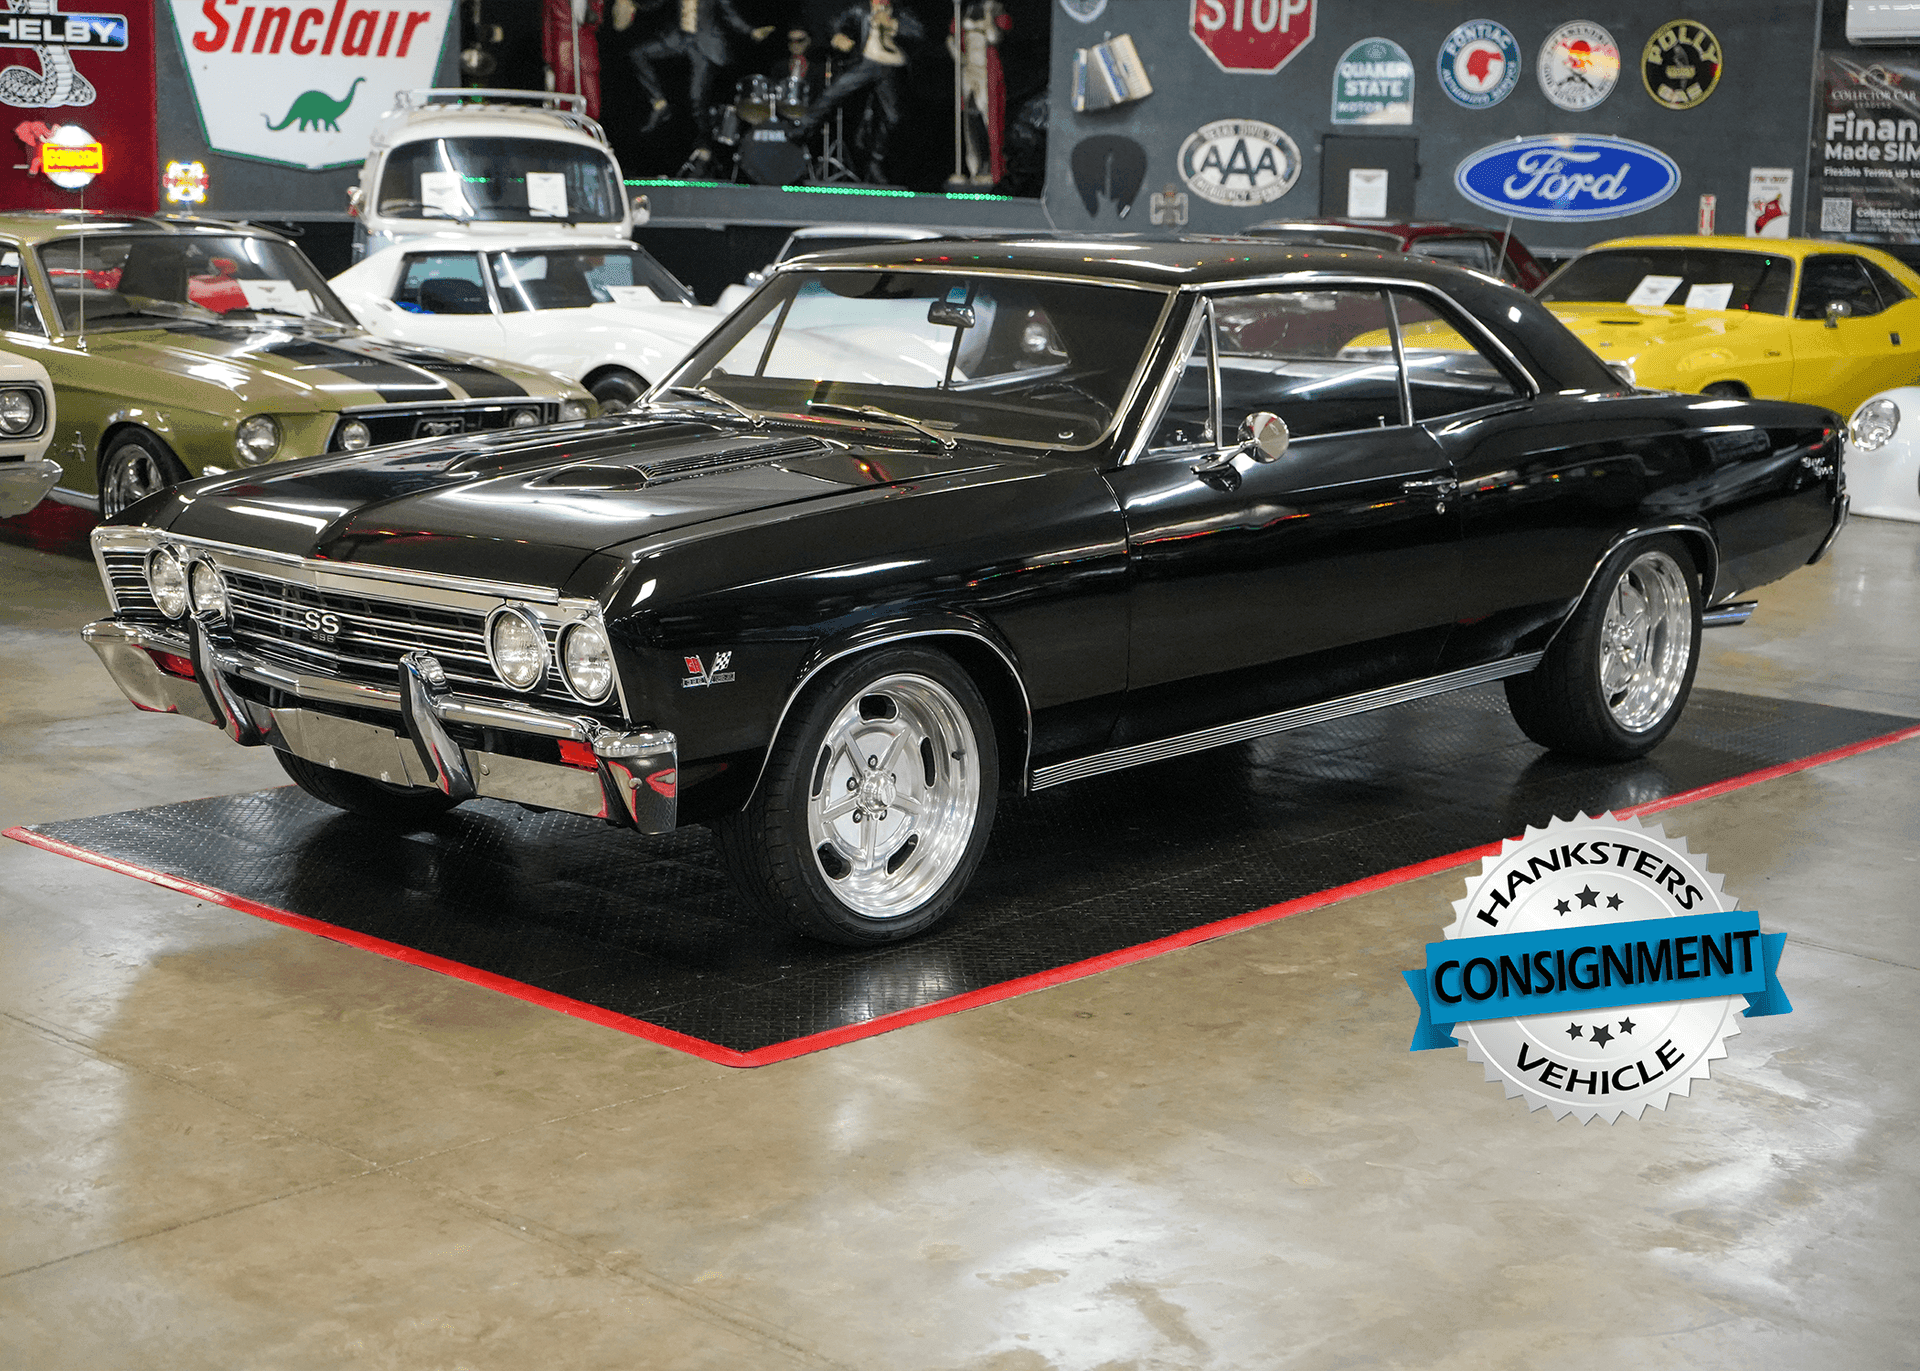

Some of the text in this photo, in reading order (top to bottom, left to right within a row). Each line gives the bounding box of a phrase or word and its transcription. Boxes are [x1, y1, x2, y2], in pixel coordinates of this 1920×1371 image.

[193, 0, 431, 57] Sinclair
[1200, 0, 1308, 33] STOP
[0, 18, 117, 43] HELBY
[1446, 25, 1512, 56] PONTIAC
[1648, 26, 1718, 65] POLLY
[1340, 61, 1412, 79] QUAKER
[1344, 79, 1404, 97] STATE
[1657, 82, 1704, 103] GAS
[1831, 89, 1917, 101] COLLECTOR CAR
[1826, 110, 1920, 141] Finan
[1200, 138, 1278, 186] AAA
[1825, 141, 1881, 161] Made
[1503, 149, 1631, 201] Ford
[1823, 166, 1920, 180] Flexible Terms up to
[305, 610, 340, 635] SS
[312, 631, 335, 643] 396
